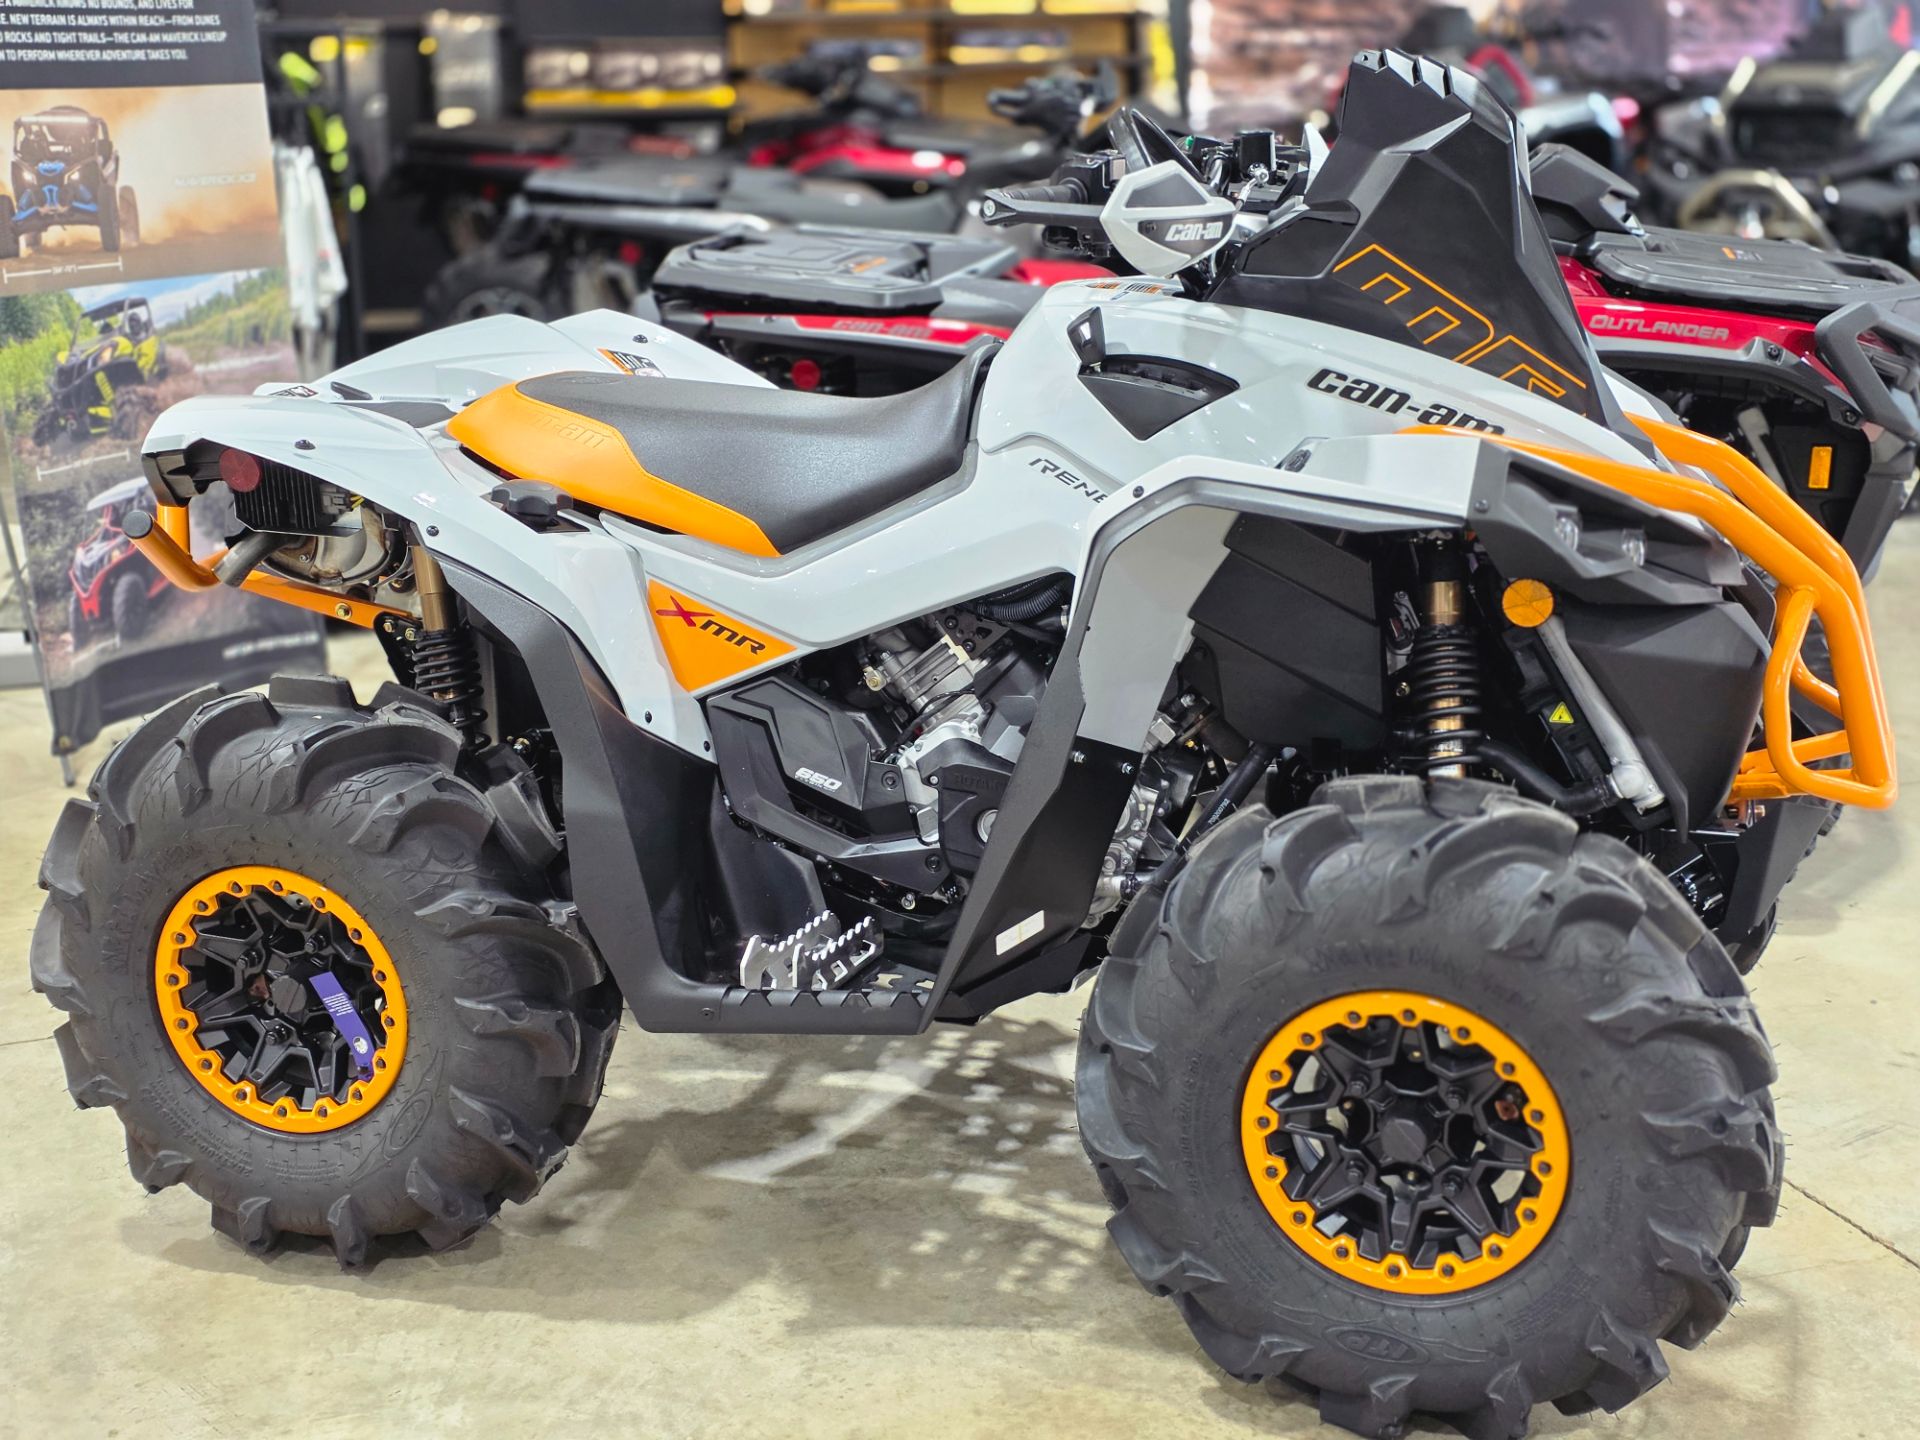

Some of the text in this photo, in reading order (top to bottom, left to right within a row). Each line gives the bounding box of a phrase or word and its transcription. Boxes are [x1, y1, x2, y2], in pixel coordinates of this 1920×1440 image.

[9, 13, 29, 25] NEW
[30, 13, 66, 25] TERRAIN
[67, 14, 76, 26] IS
[78, 14, 108, 26] ALWAYS
[4, 31, 33, 43] ROCKS
[34, 31, 51, 43] AND
[52, 31, 77, 43] TIGHT
[6, 49, 17, 61] TO
[17, 49, 56, 61] PERFORM
[56, 49, 101, 61] WHEREVER
[102, 49, 147, 61] ADVENTURE
[1588, 314, 1731, 342] OUTLANDER
[794, 766, 843, 790] 650
